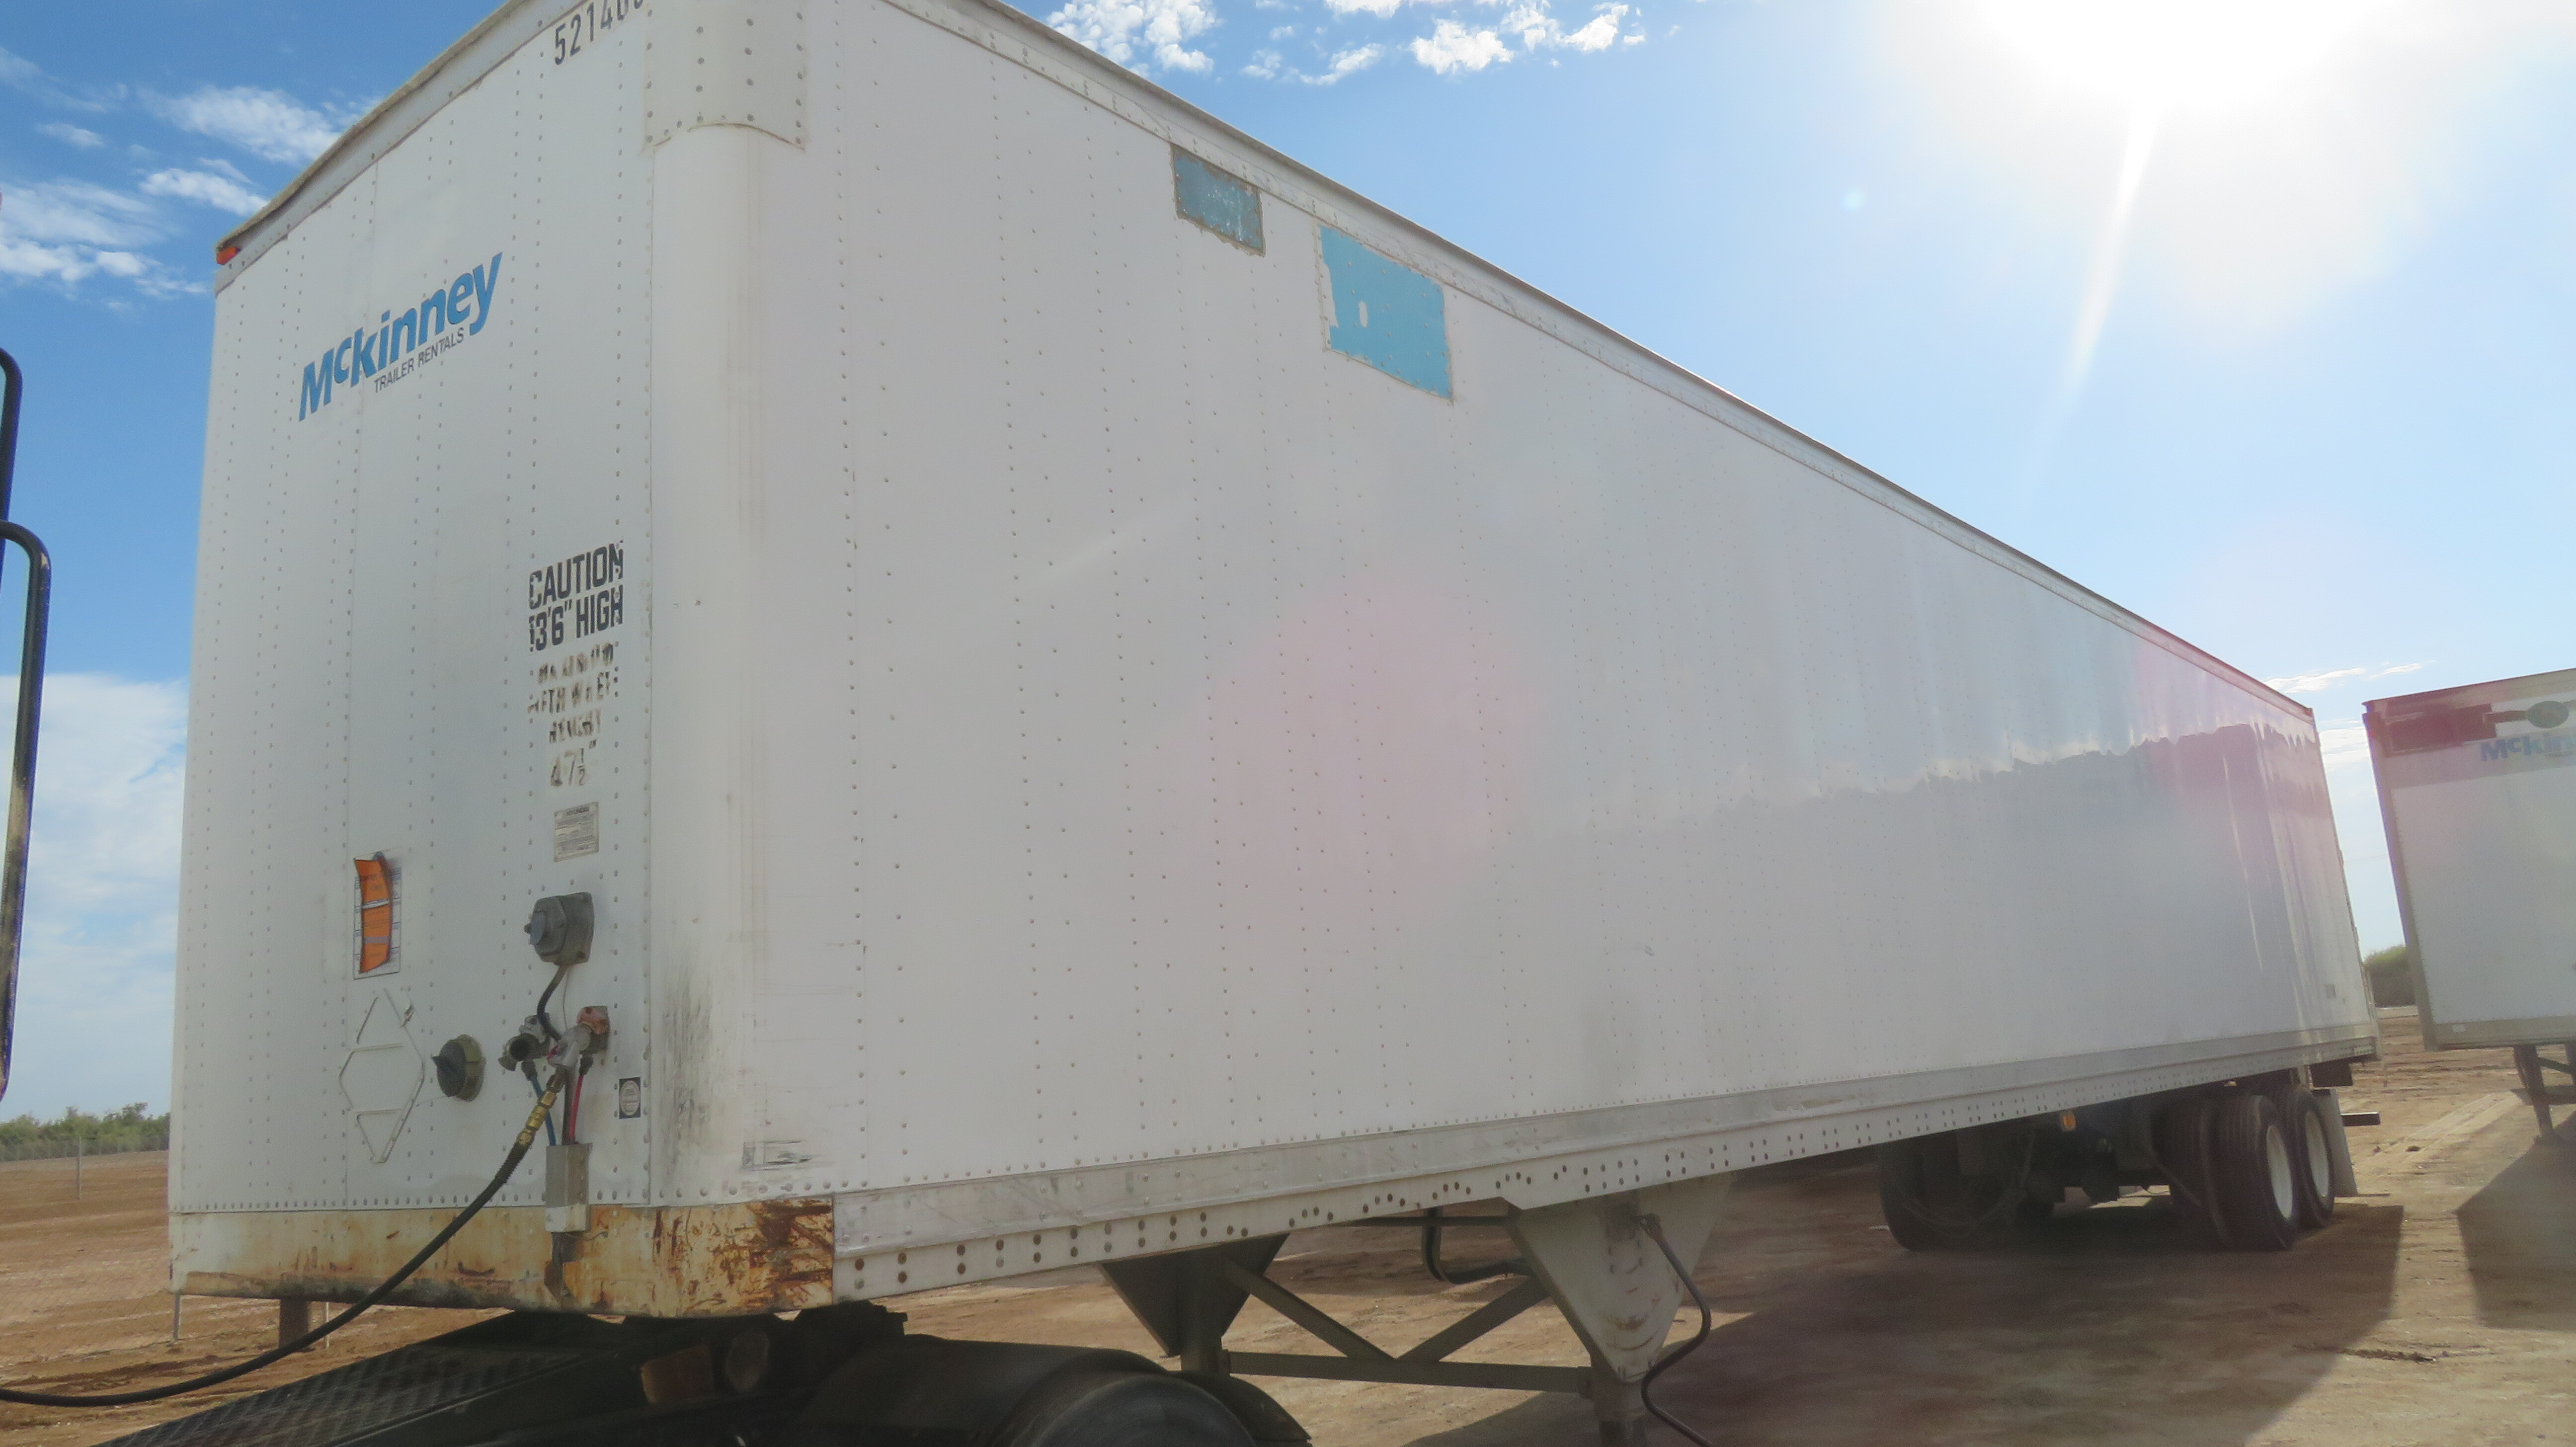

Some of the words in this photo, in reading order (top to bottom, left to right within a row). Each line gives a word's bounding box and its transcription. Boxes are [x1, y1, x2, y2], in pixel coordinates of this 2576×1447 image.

[374, 358, 414, 393] TRAILER
[418, 327, 464, 368] RENTALS
[529, 543, 623, 610] CAUTION
[576, 584, 623, 638] HIGH
